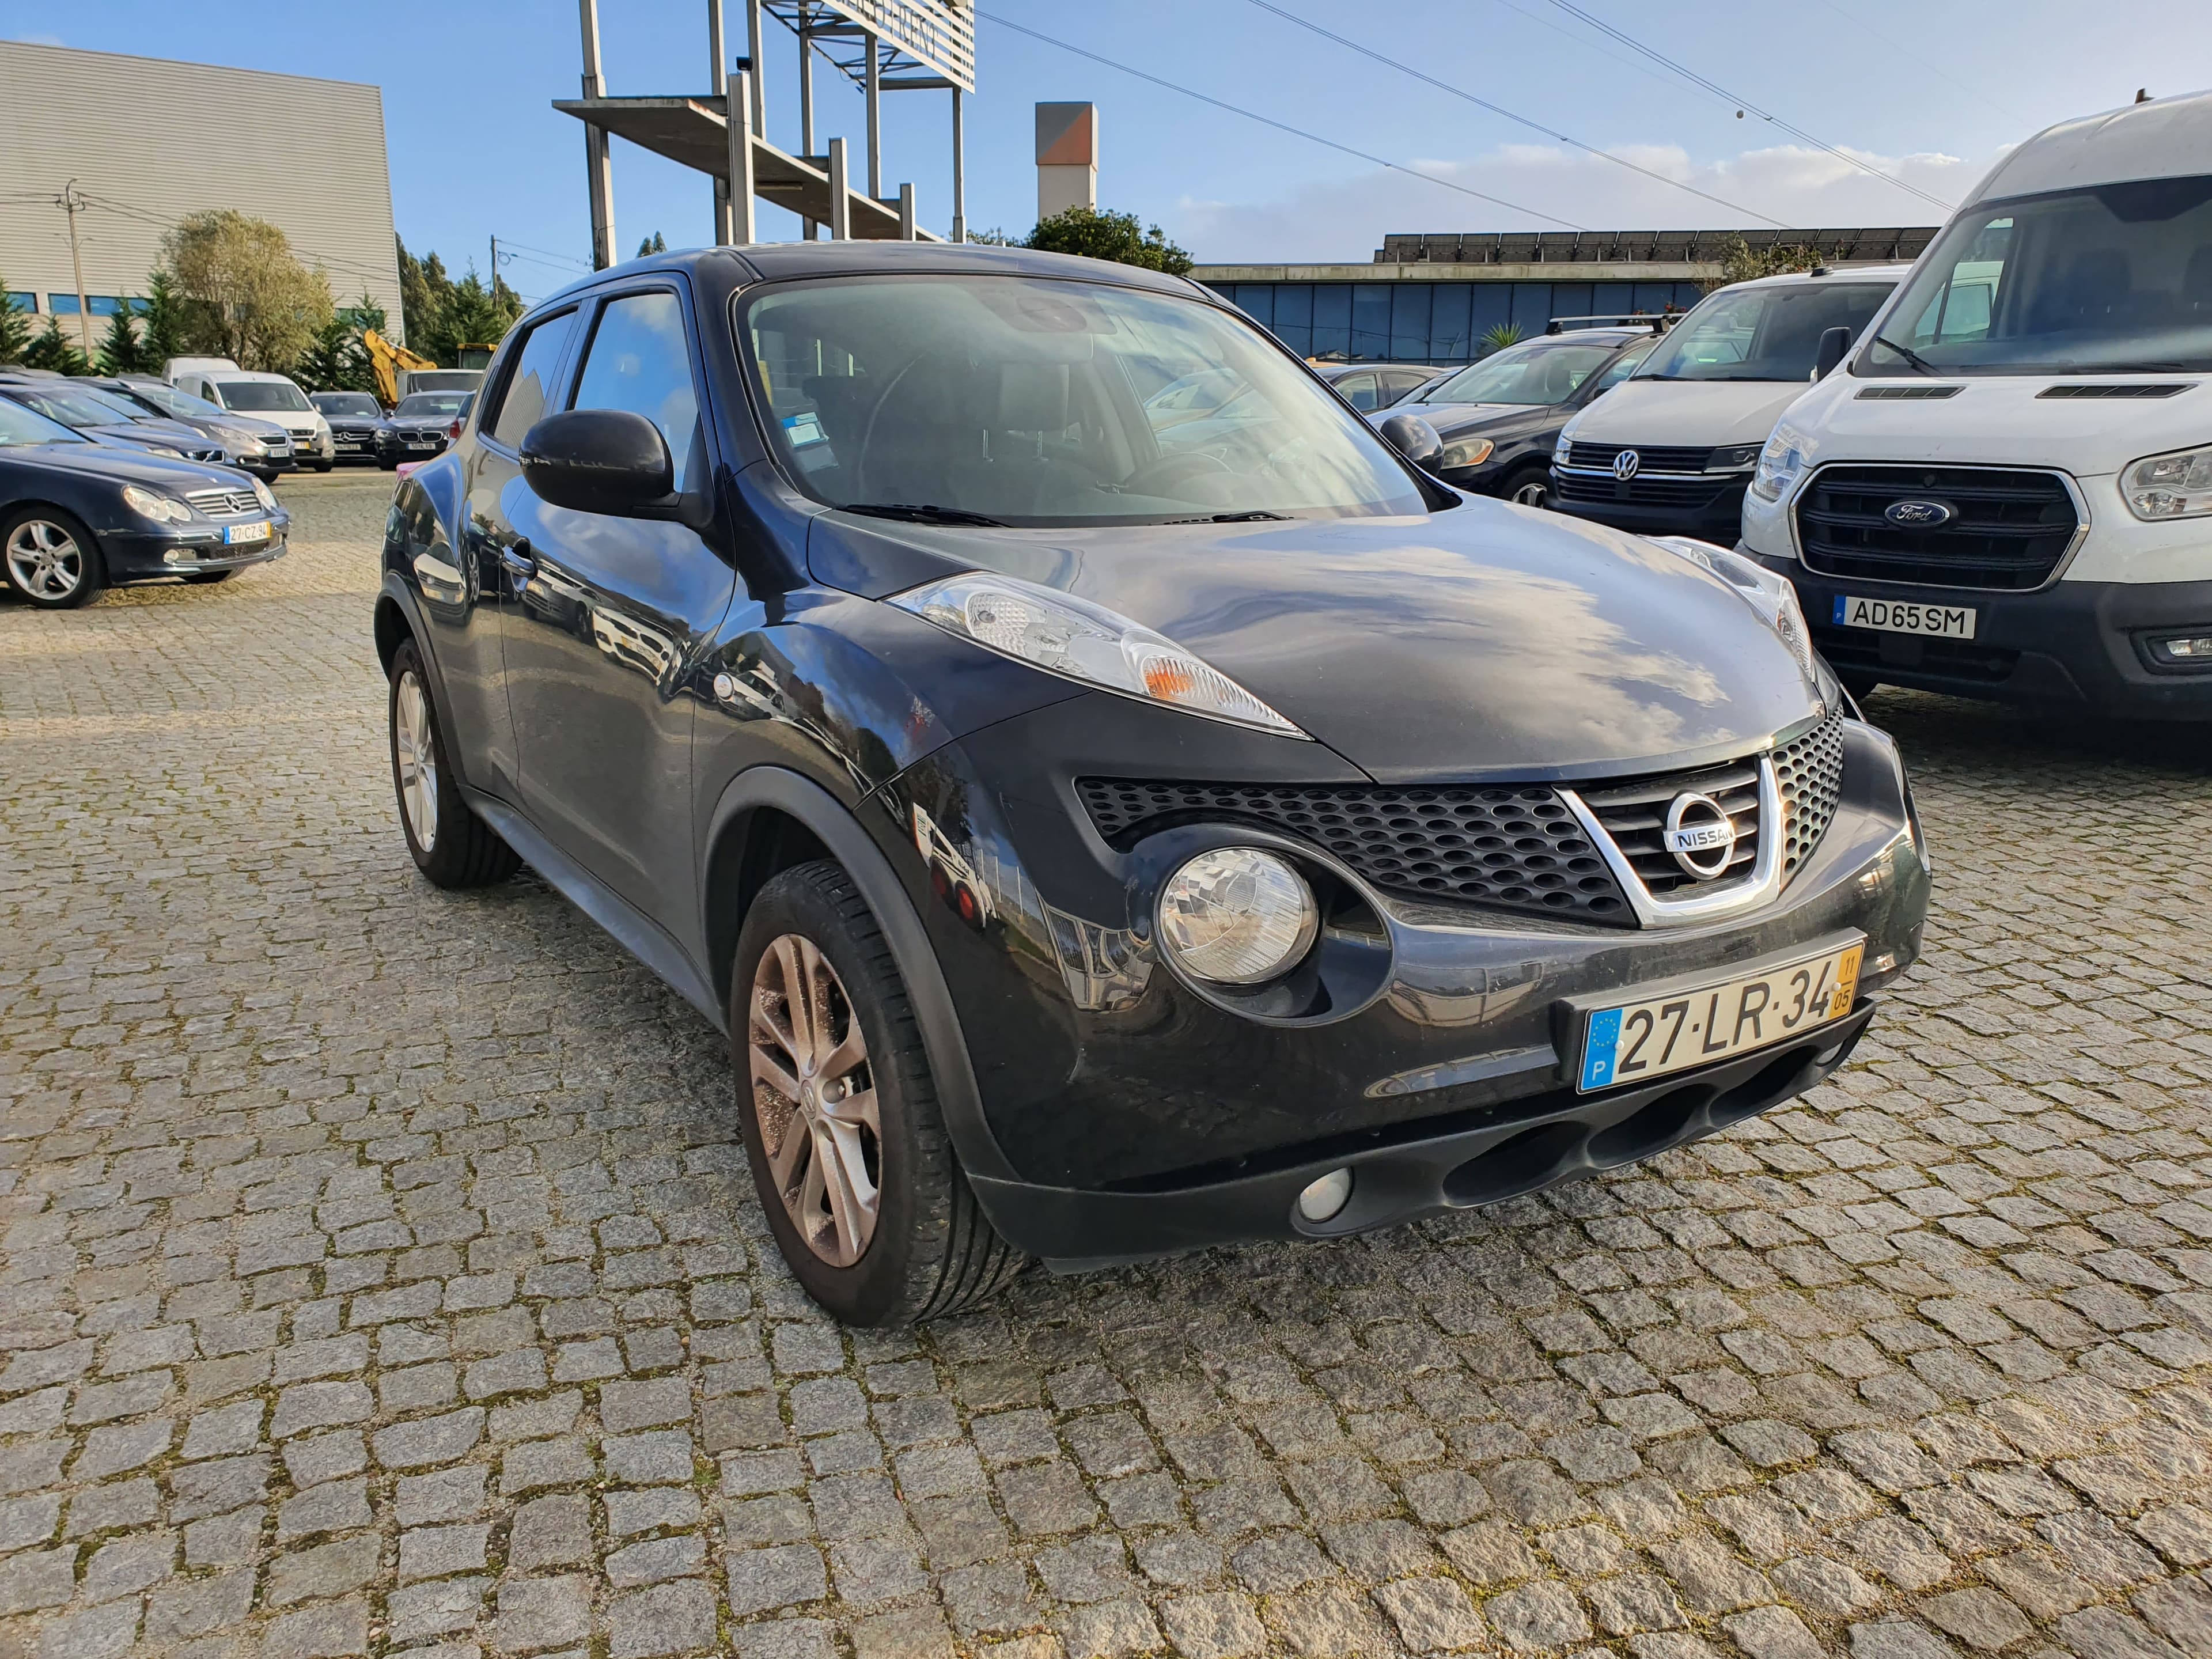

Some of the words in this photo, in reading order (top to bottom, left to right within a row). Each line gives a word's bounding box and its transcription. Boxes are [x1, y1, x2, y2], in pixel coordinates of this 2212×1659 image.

[1896, 505, 1932, 521] Ford
[1677, 828, 1733, 847] NISSAN
[1834, 989, 1850, 1010] 05
[1592, 1060, 1606, 1081] P
